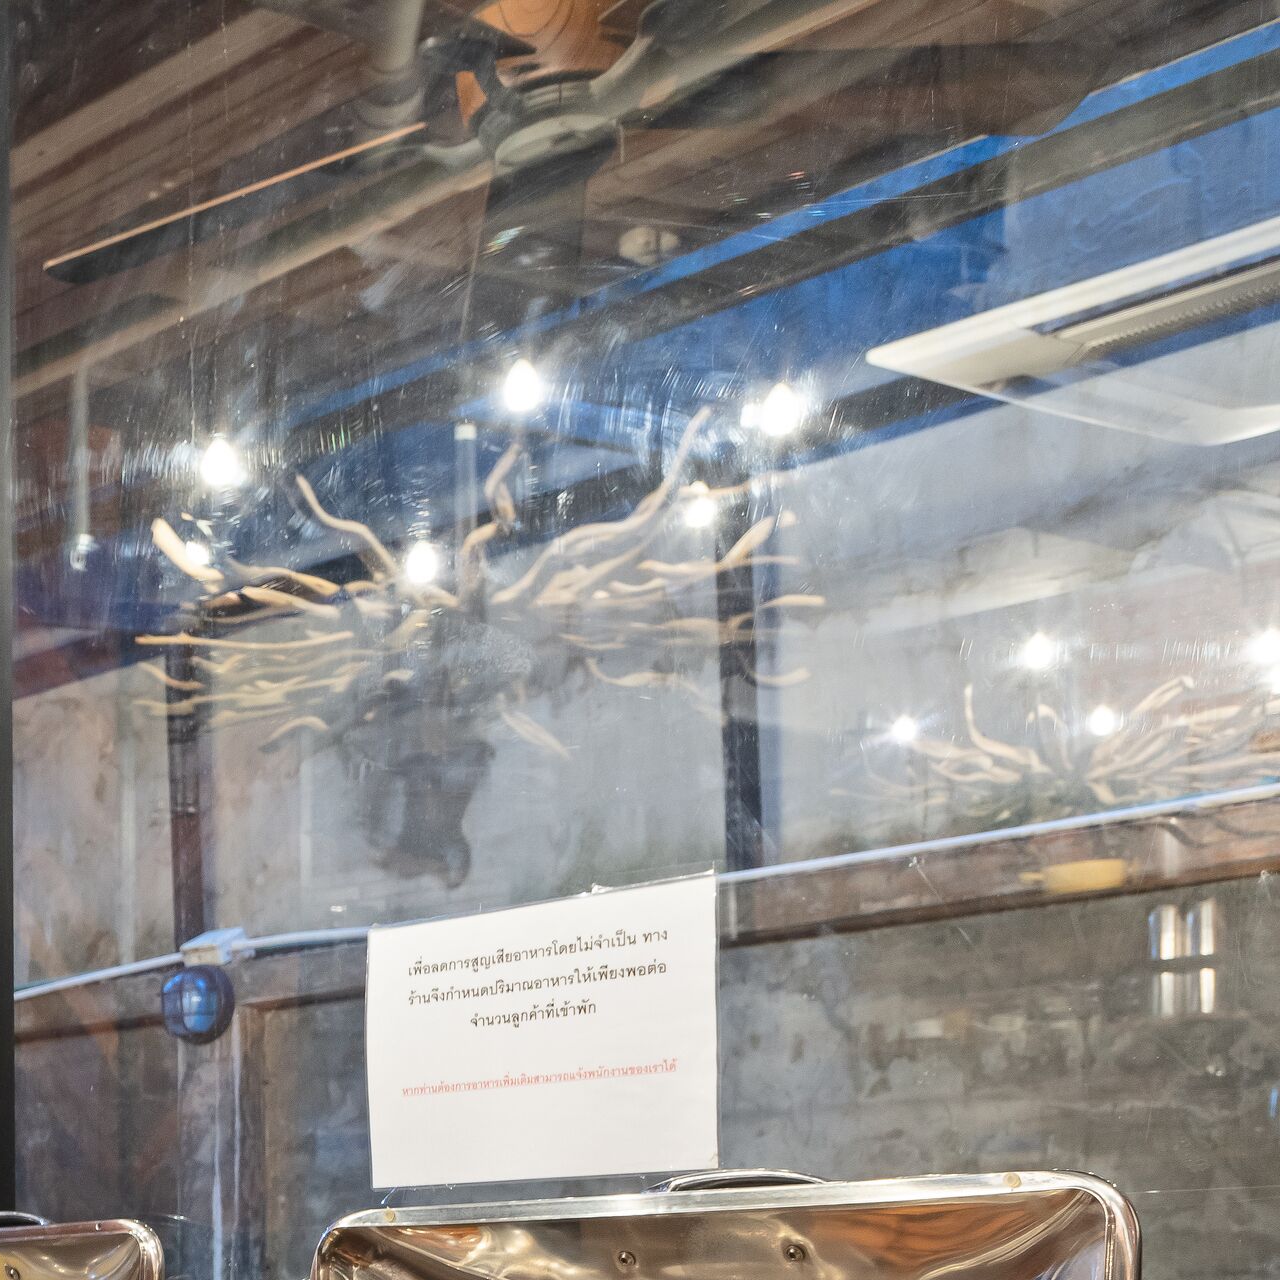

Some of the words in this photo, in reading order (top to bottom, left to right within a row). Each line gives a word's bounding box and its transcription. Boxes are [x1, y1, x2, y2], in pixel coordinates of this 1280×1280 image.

[408, 929, 637, 976] เพื่อลดการสูญเสียอาหารโดยไม่จำเป็น
[642, 930, 668, 943] ทาง
[408, 959, 667, 1005] ร้านจึงกำหนดปริมาณอาหารให้เพียงพอต่อ
[470, 998, 597, 1028] จำนวนลูกค้าที่เข้าพัก
